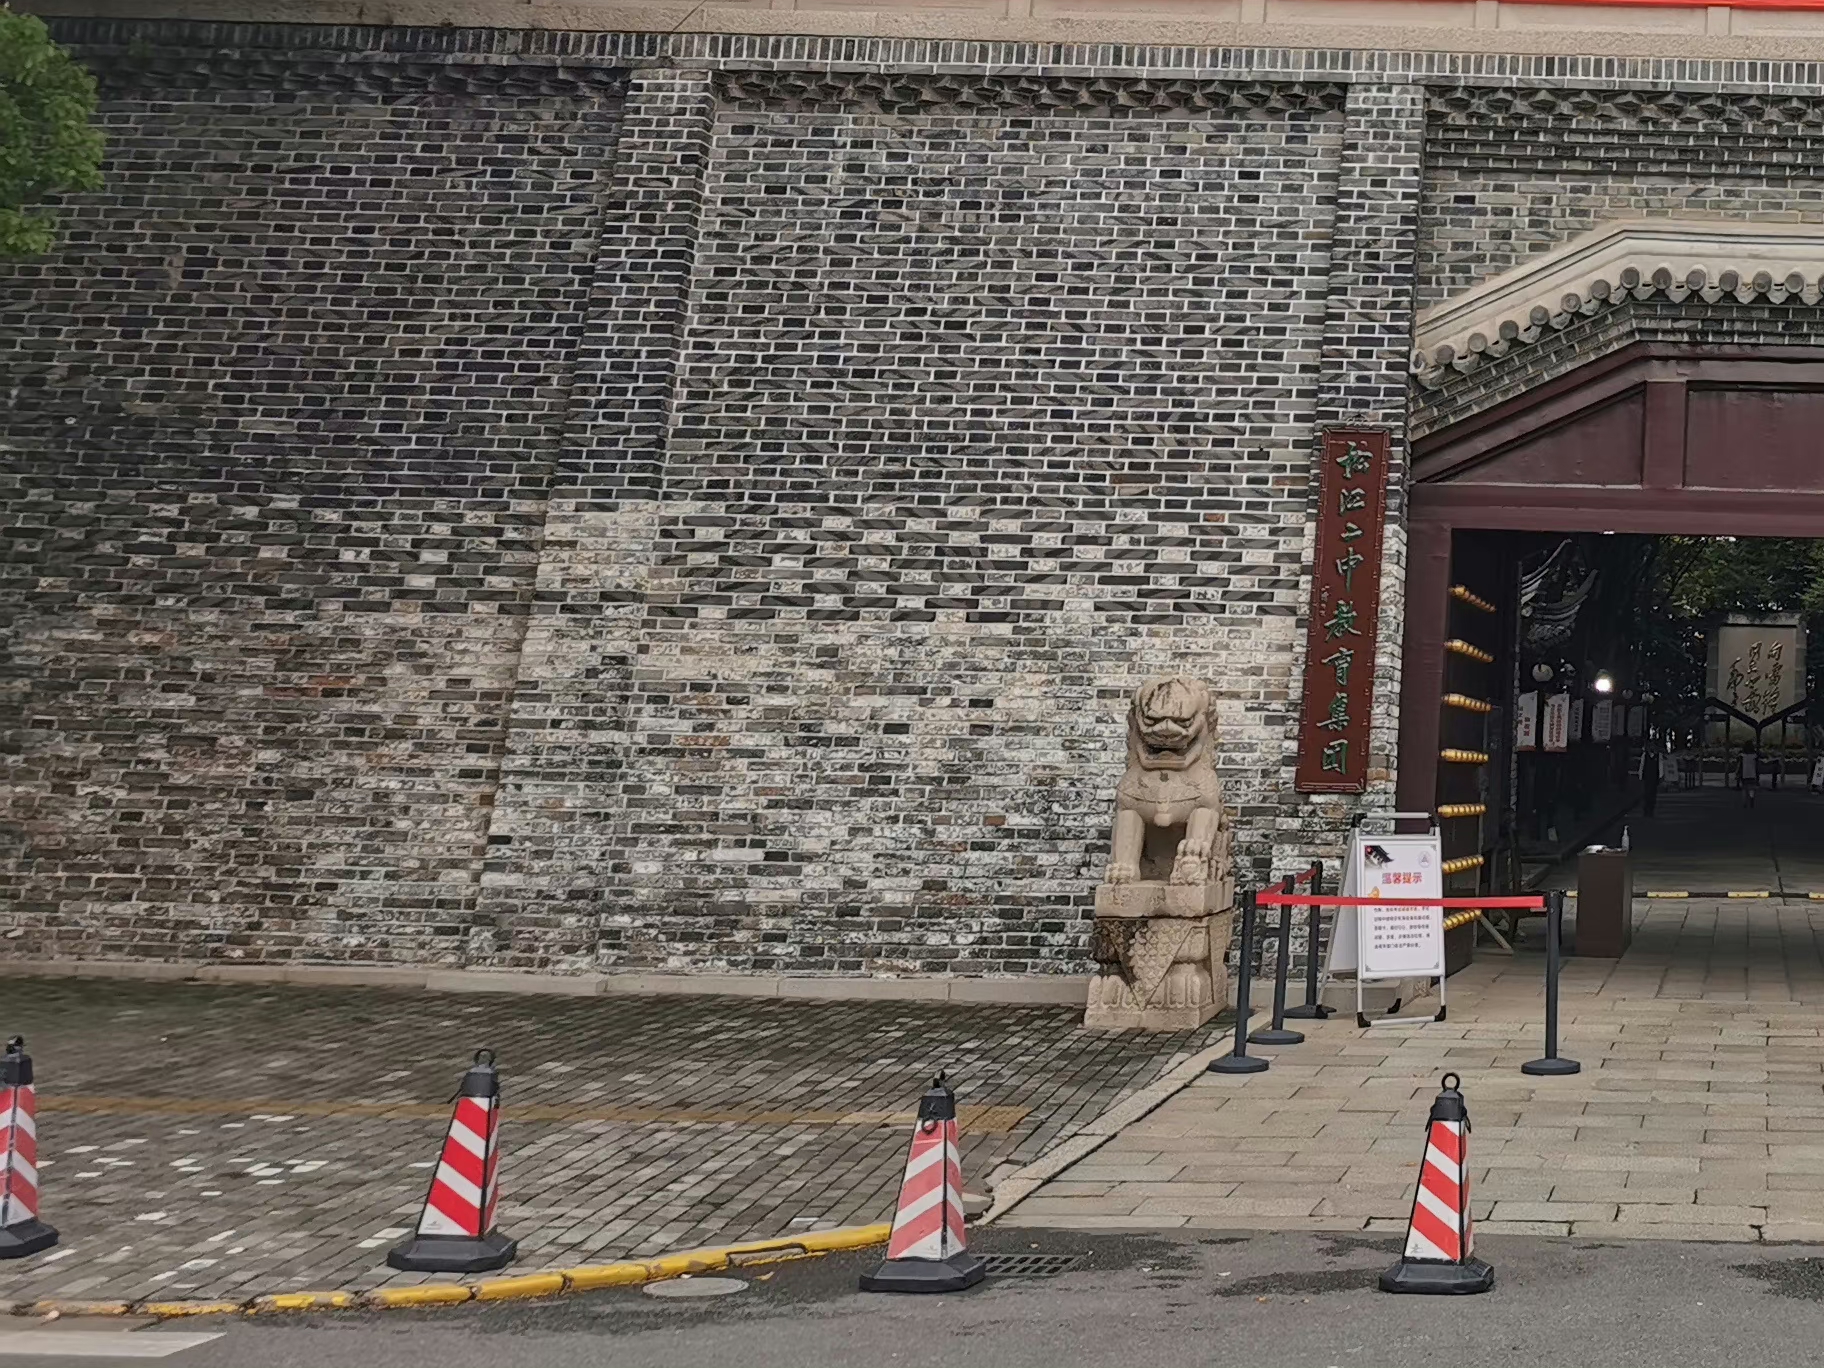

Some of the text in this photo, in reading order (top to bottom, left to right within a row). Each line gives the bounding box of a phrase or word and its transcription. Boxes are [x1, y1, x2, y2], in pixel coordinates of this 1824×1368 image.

[1317, 441, 1374, 775] 松江二中教育集团
